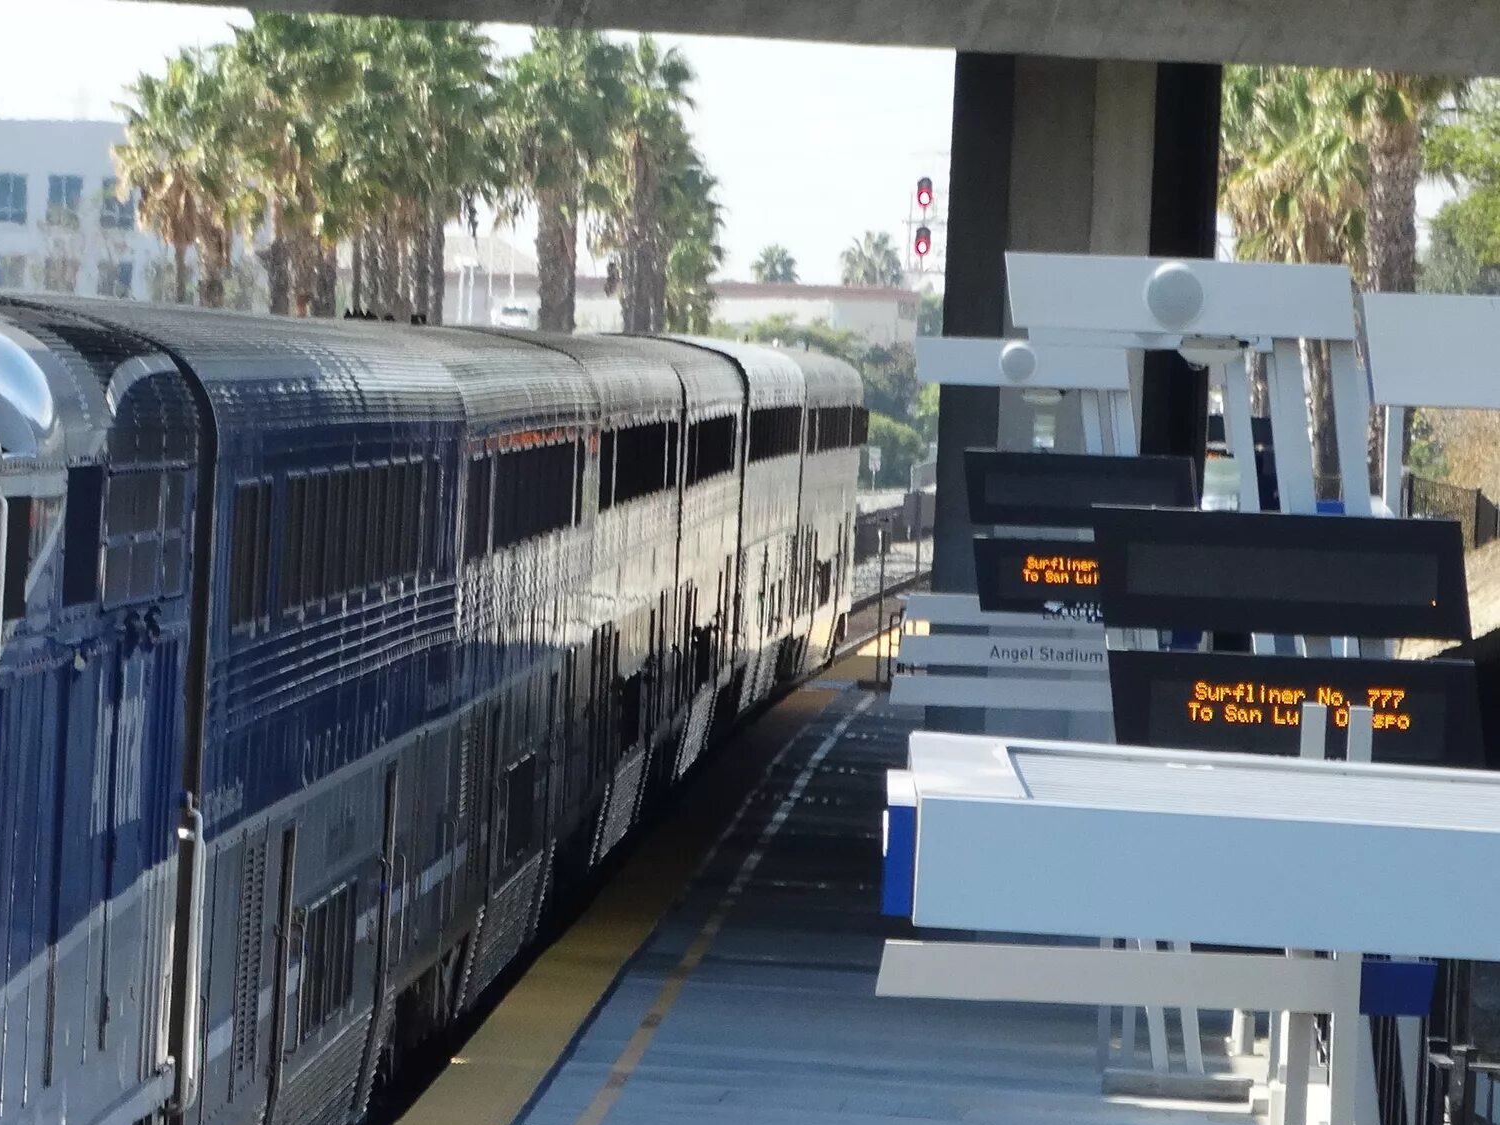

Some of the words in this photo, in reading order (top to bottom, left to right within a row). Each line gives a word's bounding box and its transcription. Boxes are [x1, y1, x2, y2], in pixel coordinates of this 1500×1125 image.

[1077, 573, 1100, 585] Lui
[989, 645, 1033, 663] Angel
[1040, 647, 1103, 663] Stadium
[1196, 682, 1306, 705] Surfliner
[1318, 687, 1351, 706] No.
[1368, 688, 1405, 709] 777
[1188, 702, 1213, 722] To
[1225, 704, 1262, 724] San
[1336, 709, 1411, 730] Ospo
